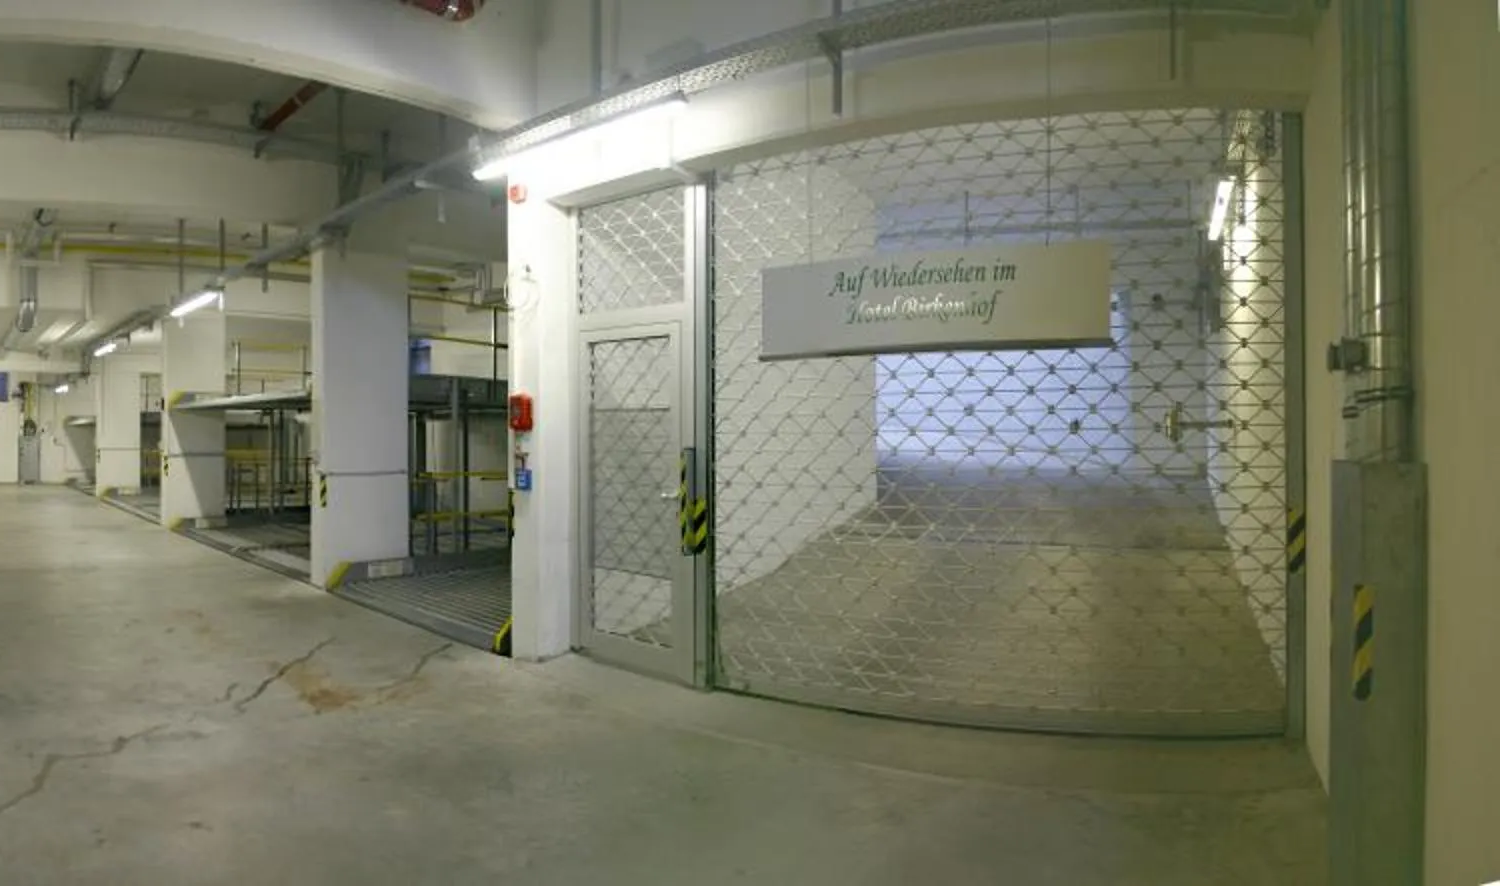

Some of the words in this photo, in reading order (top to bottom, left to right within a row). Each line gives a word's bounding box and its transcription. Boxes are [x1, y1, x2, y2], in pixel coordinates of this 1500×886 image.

[828, 265, 869, 299] Auf
[871, 257, 986, 288] Wiedersehen
[993, 257, 1016, 281] im
